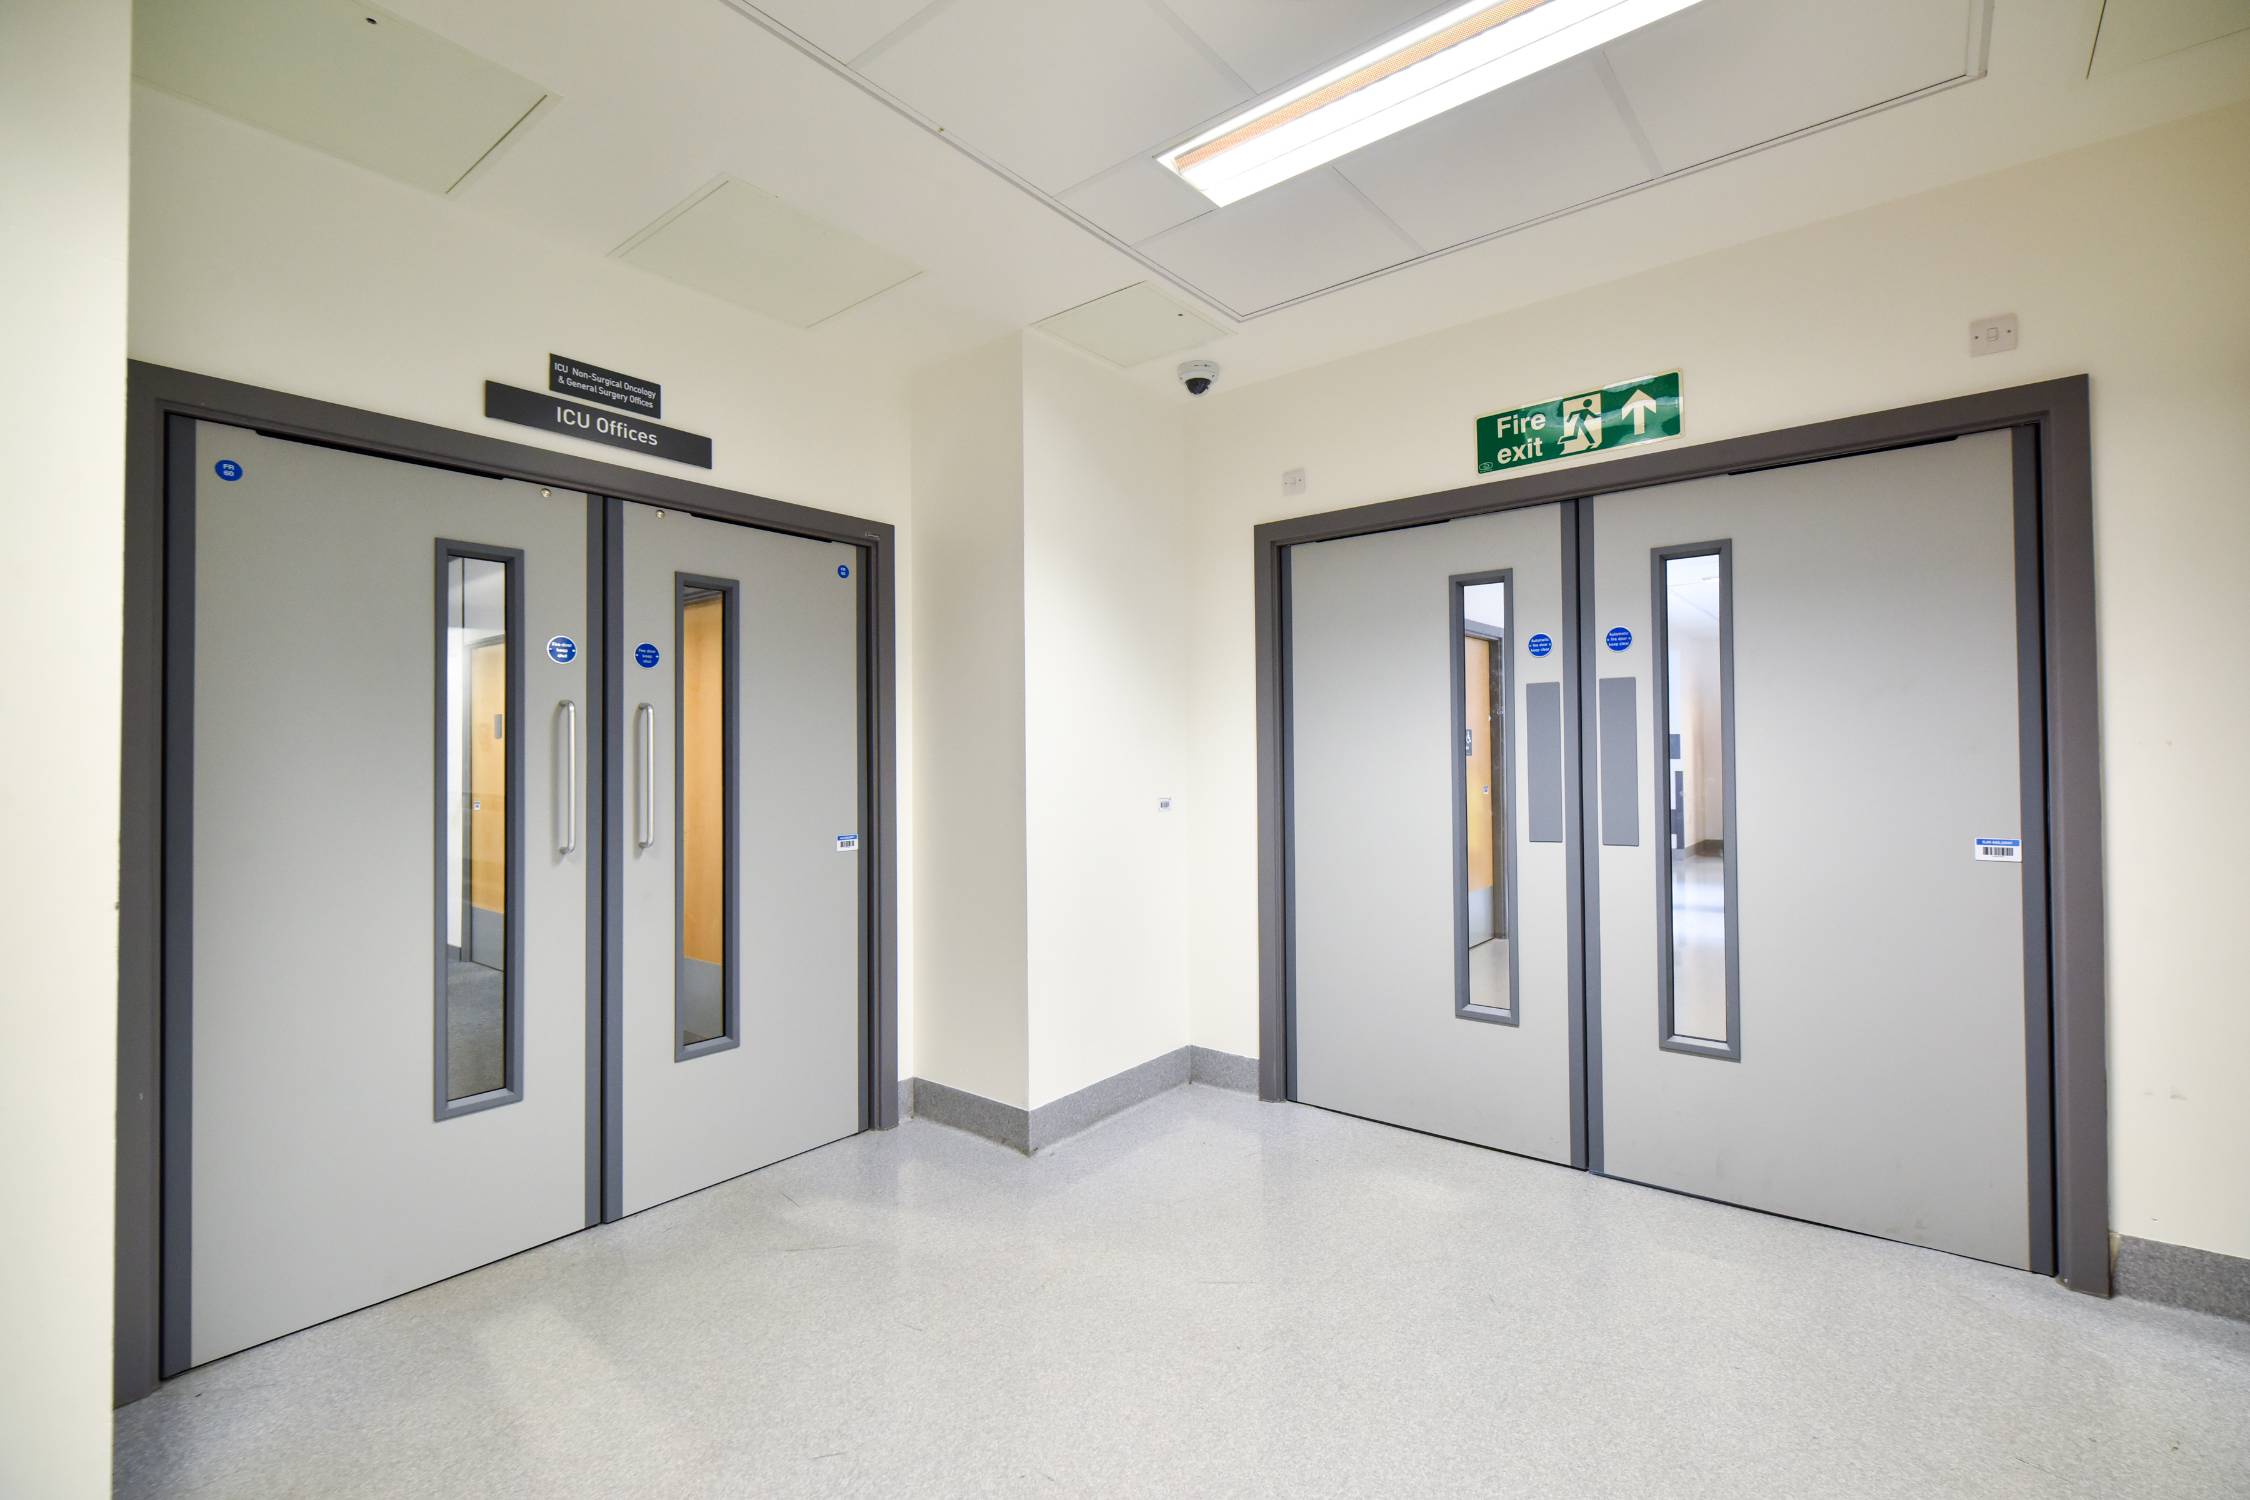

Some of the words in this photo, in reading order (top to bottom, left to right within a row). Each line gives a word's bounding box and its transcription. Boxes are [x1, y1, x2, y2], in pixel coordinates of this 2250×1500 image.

[554, 362, 569, 373] ICU
[572, 367, 623, 389] Non-Surgical
[623, 382, 657, 400] Oncology
[558, 375, 565, 385] &
[566, 377, 598, 393] General
[598, 386, 628, 402] Surgery
[629, 395, 654, 409] Offices
[556, 406, 590, 429] ICU
[596, 417, 658, 446] Offices
[1497, 413, 1546, 438] Fire
[1497, 437, 1543, 464] exit
